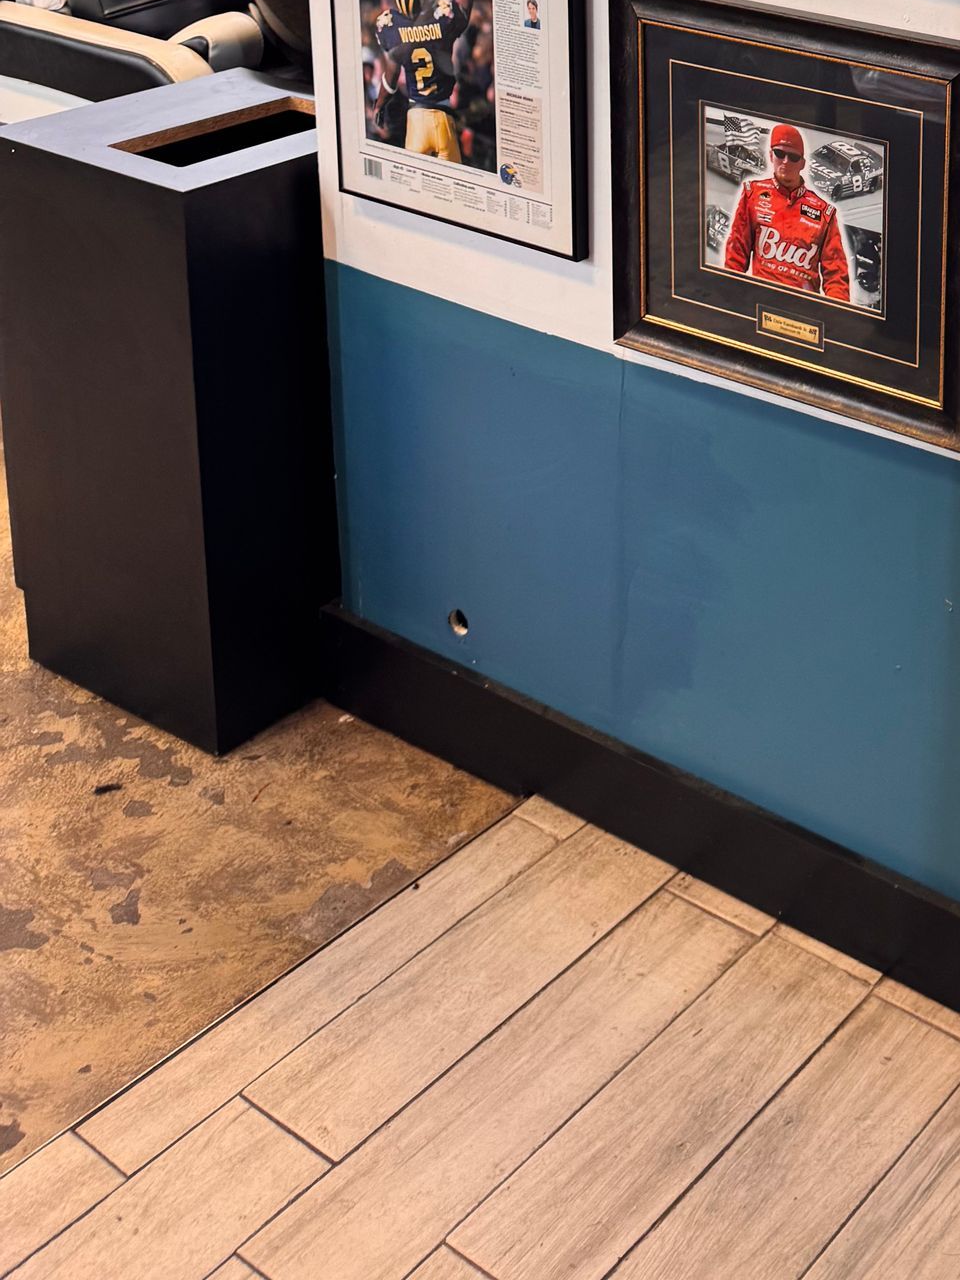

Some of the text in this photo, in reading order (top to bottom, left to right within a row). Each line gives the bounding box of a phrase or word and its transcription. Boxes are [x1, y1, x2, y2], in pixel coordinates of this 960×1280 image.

[399, 22, 442, 45] WOODSON
[410, 47, 437, 97] 2
[718, 152, 732, 175] 8
[852, 175, 864, 193] 8
[758, 224, 819, 270] Bud
